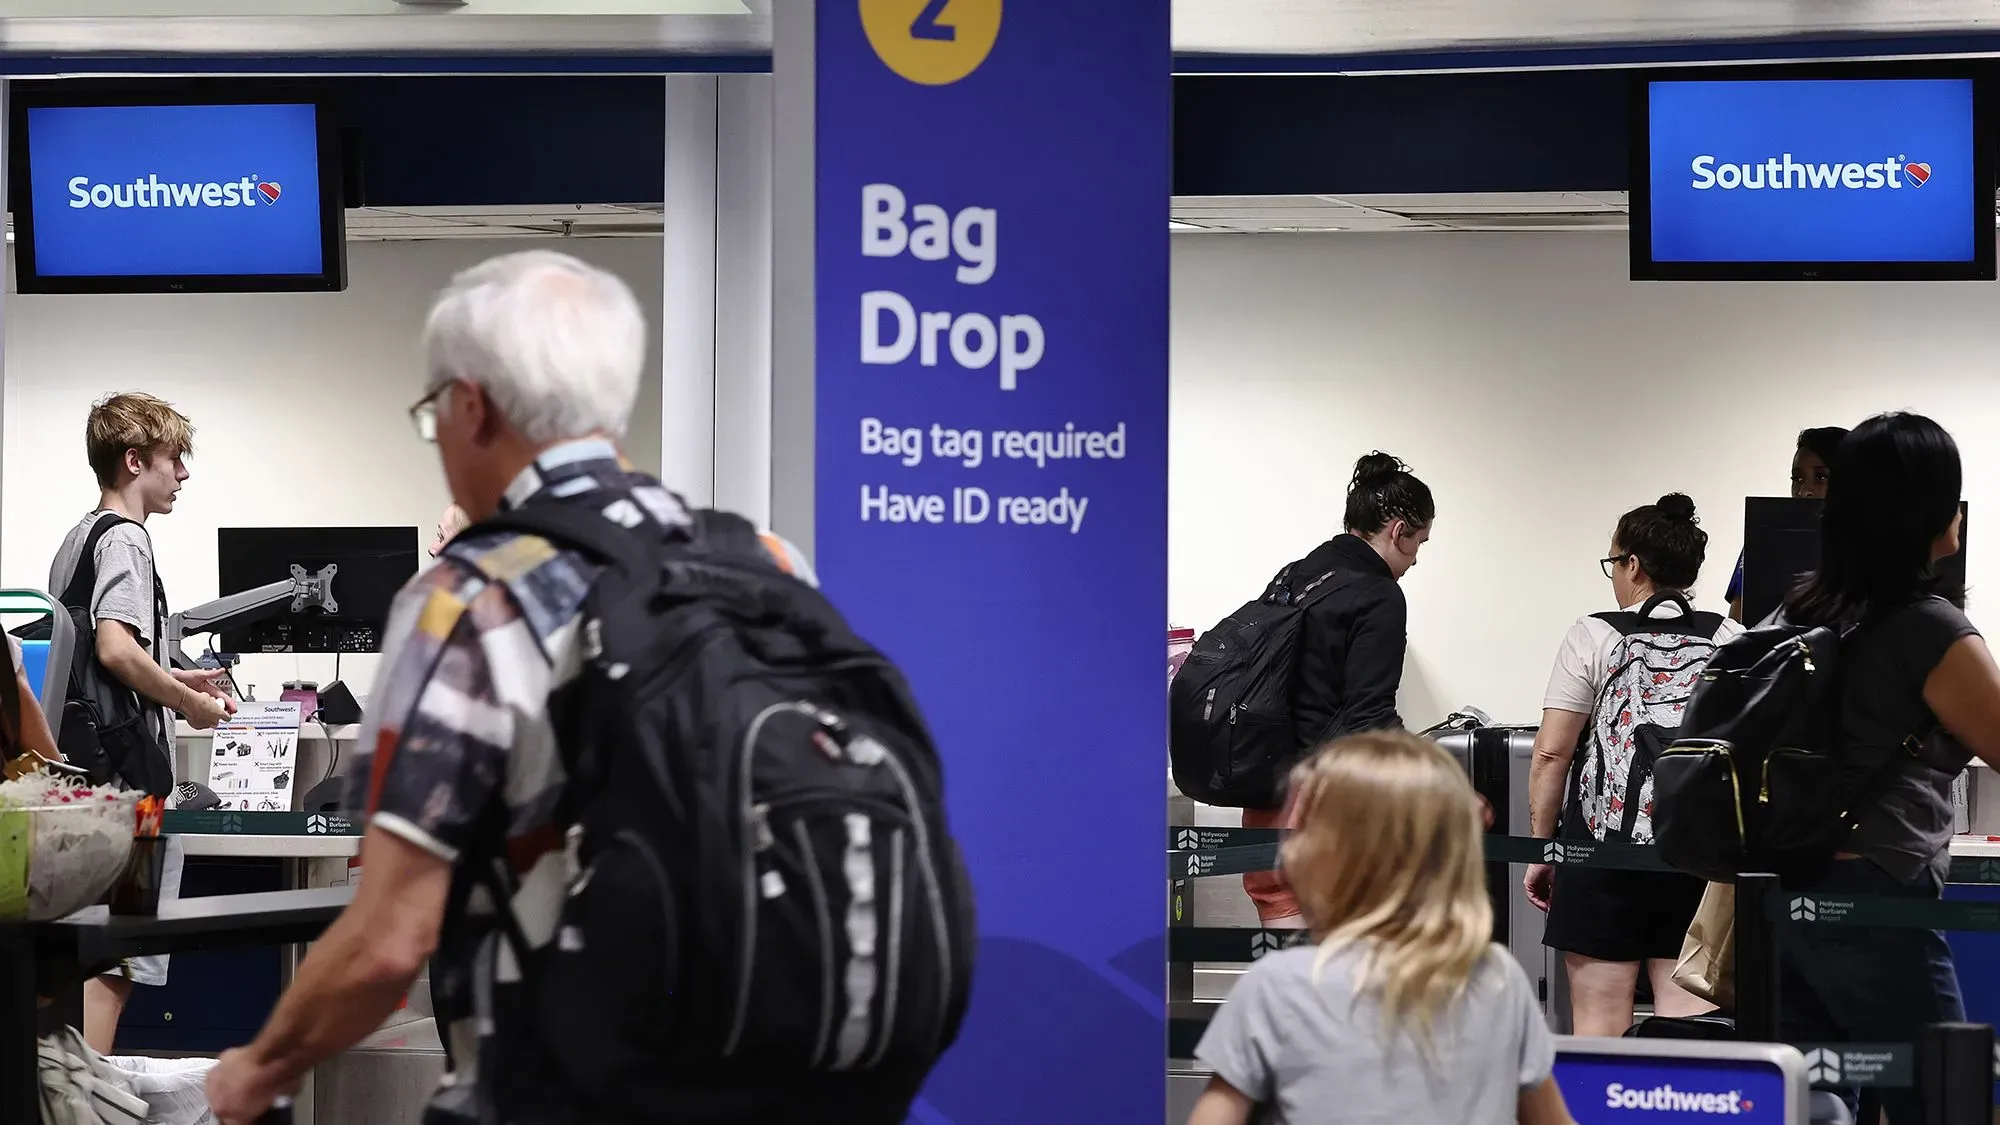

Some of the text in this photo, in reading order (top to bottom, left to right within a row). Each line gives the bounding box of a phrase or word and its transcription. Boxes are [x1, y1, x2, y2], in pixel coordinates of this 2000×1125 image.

[909, 0, 956, 42] 2
[68, 174, 256, 208] Southwest
[1691, 152, 1902, 190] Southwest
[861, 183, 997, 285] Bag
[860, 290, 1045, 391] Drop
[860, 417, 1126, 468] Bag tag required
[860, 484, 1089, 534] Have ID ready
[1606, 1082, 1741, 1115] Southwest
